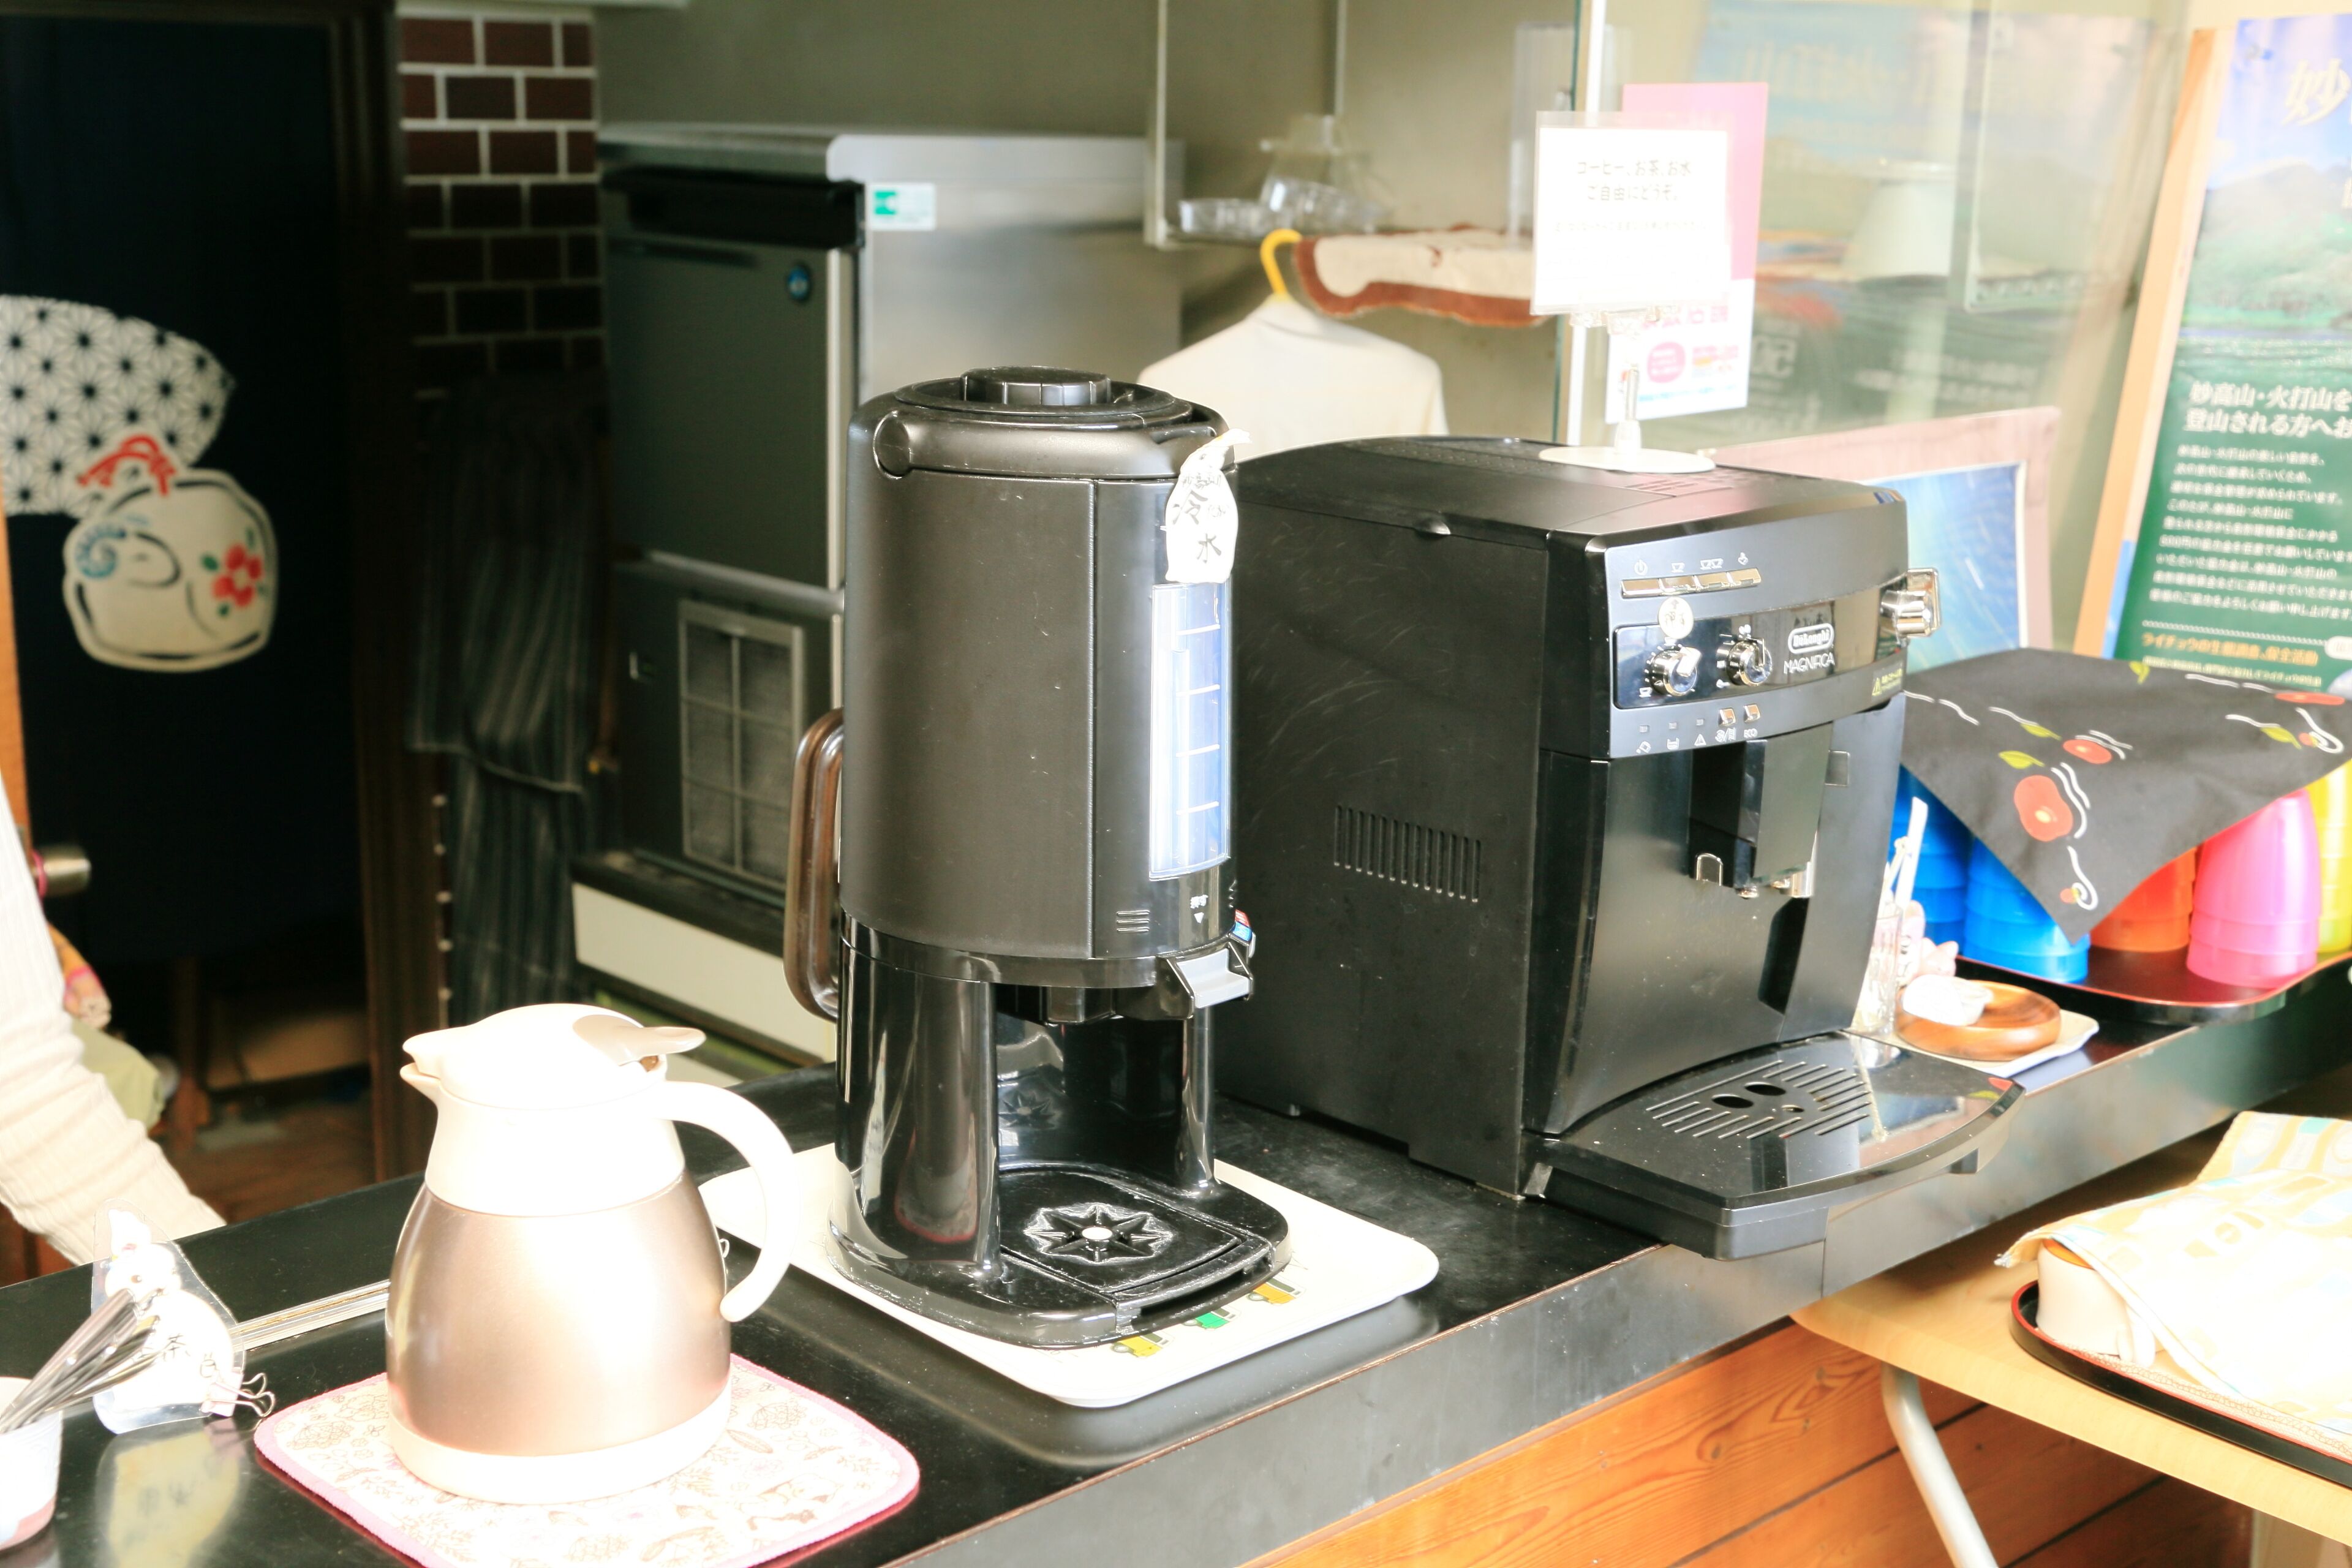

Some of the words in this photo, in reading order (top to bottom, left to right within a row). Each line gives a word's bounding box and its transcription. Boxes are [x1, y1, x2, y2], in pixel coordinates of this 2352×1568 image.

[1577, 159, 1691, 176] コーヒー、お茶、お水
[1588, 184, 1679, 202] ご自由にどうぞ。
[2188, 382, 2352, 411] 妙高山・火打山を
